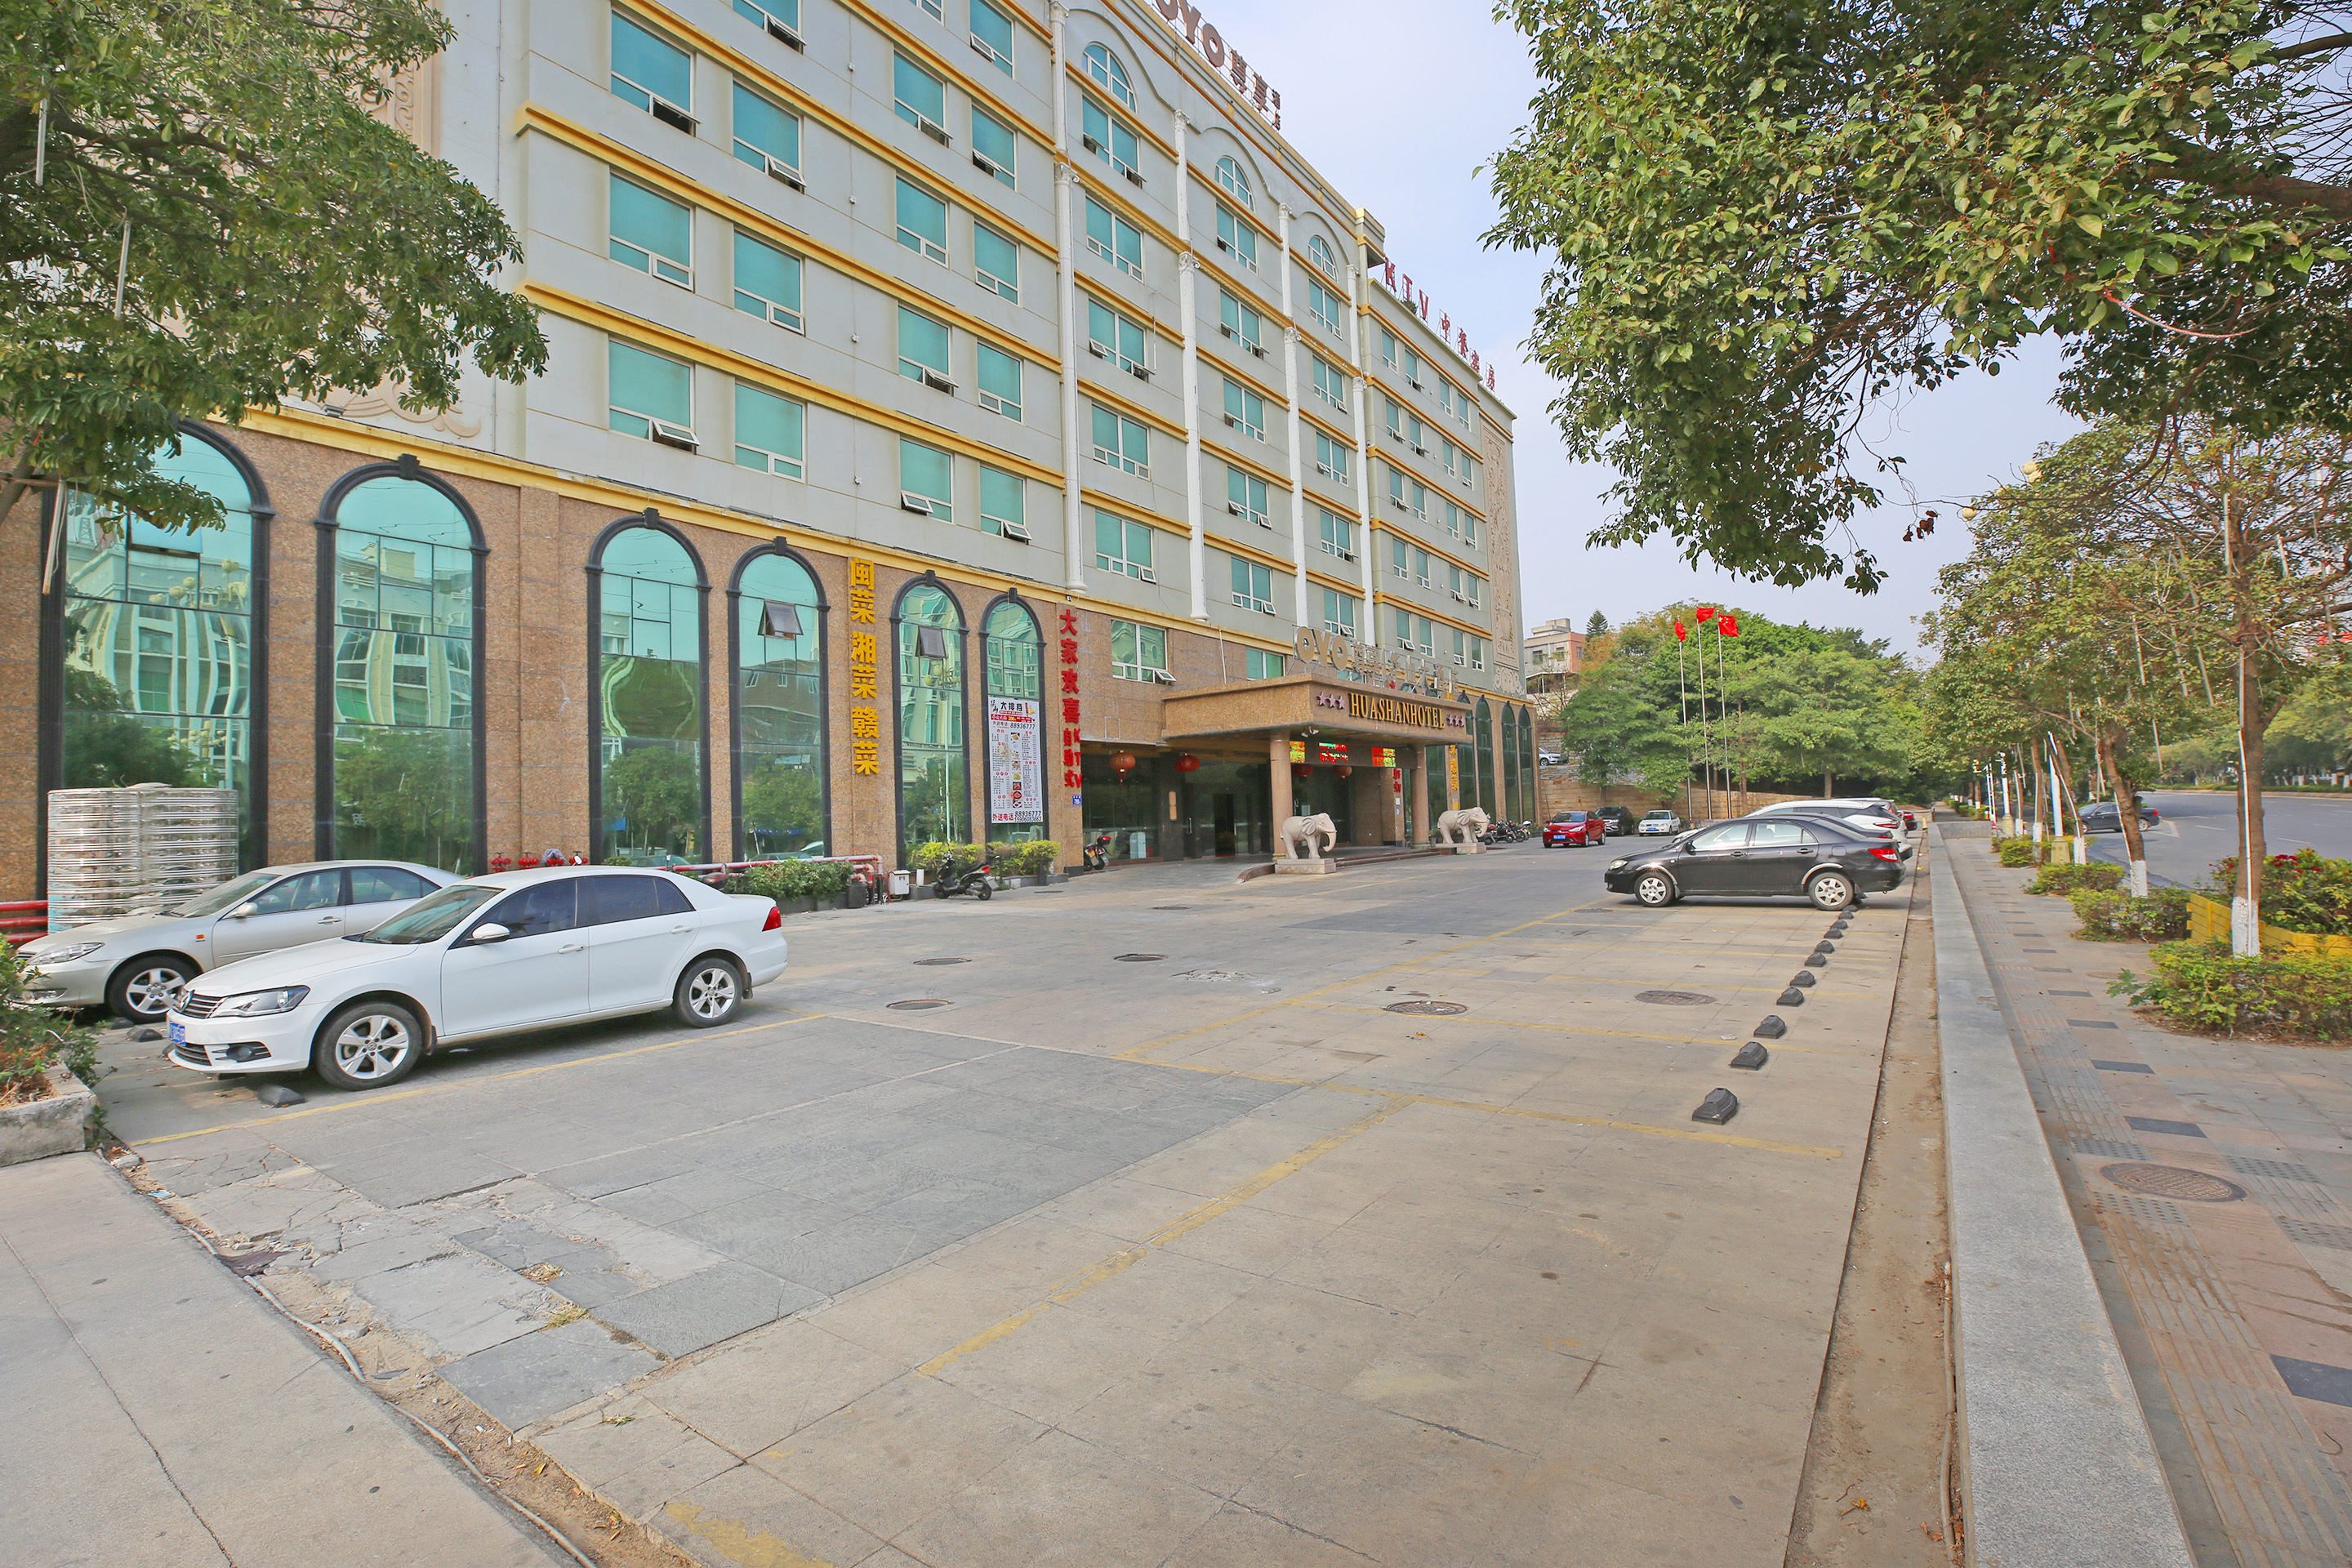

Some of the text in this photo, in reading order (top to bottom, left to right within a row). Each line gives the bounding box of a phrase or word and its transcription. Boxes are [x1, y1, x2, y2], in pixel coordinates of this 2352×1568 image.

[1385, 256, 1429, 320] KTV
[849, 556, 880, 775] 闽菜 湘菜 赣菜
[1059, 608, 1081, 724] 大家欢喜
[1294, 626, 1348, 670] OYO
[1349, 693, 1446, 729] HUASHANHOTEL
[992, 813, 1013, 822] 外送电话
